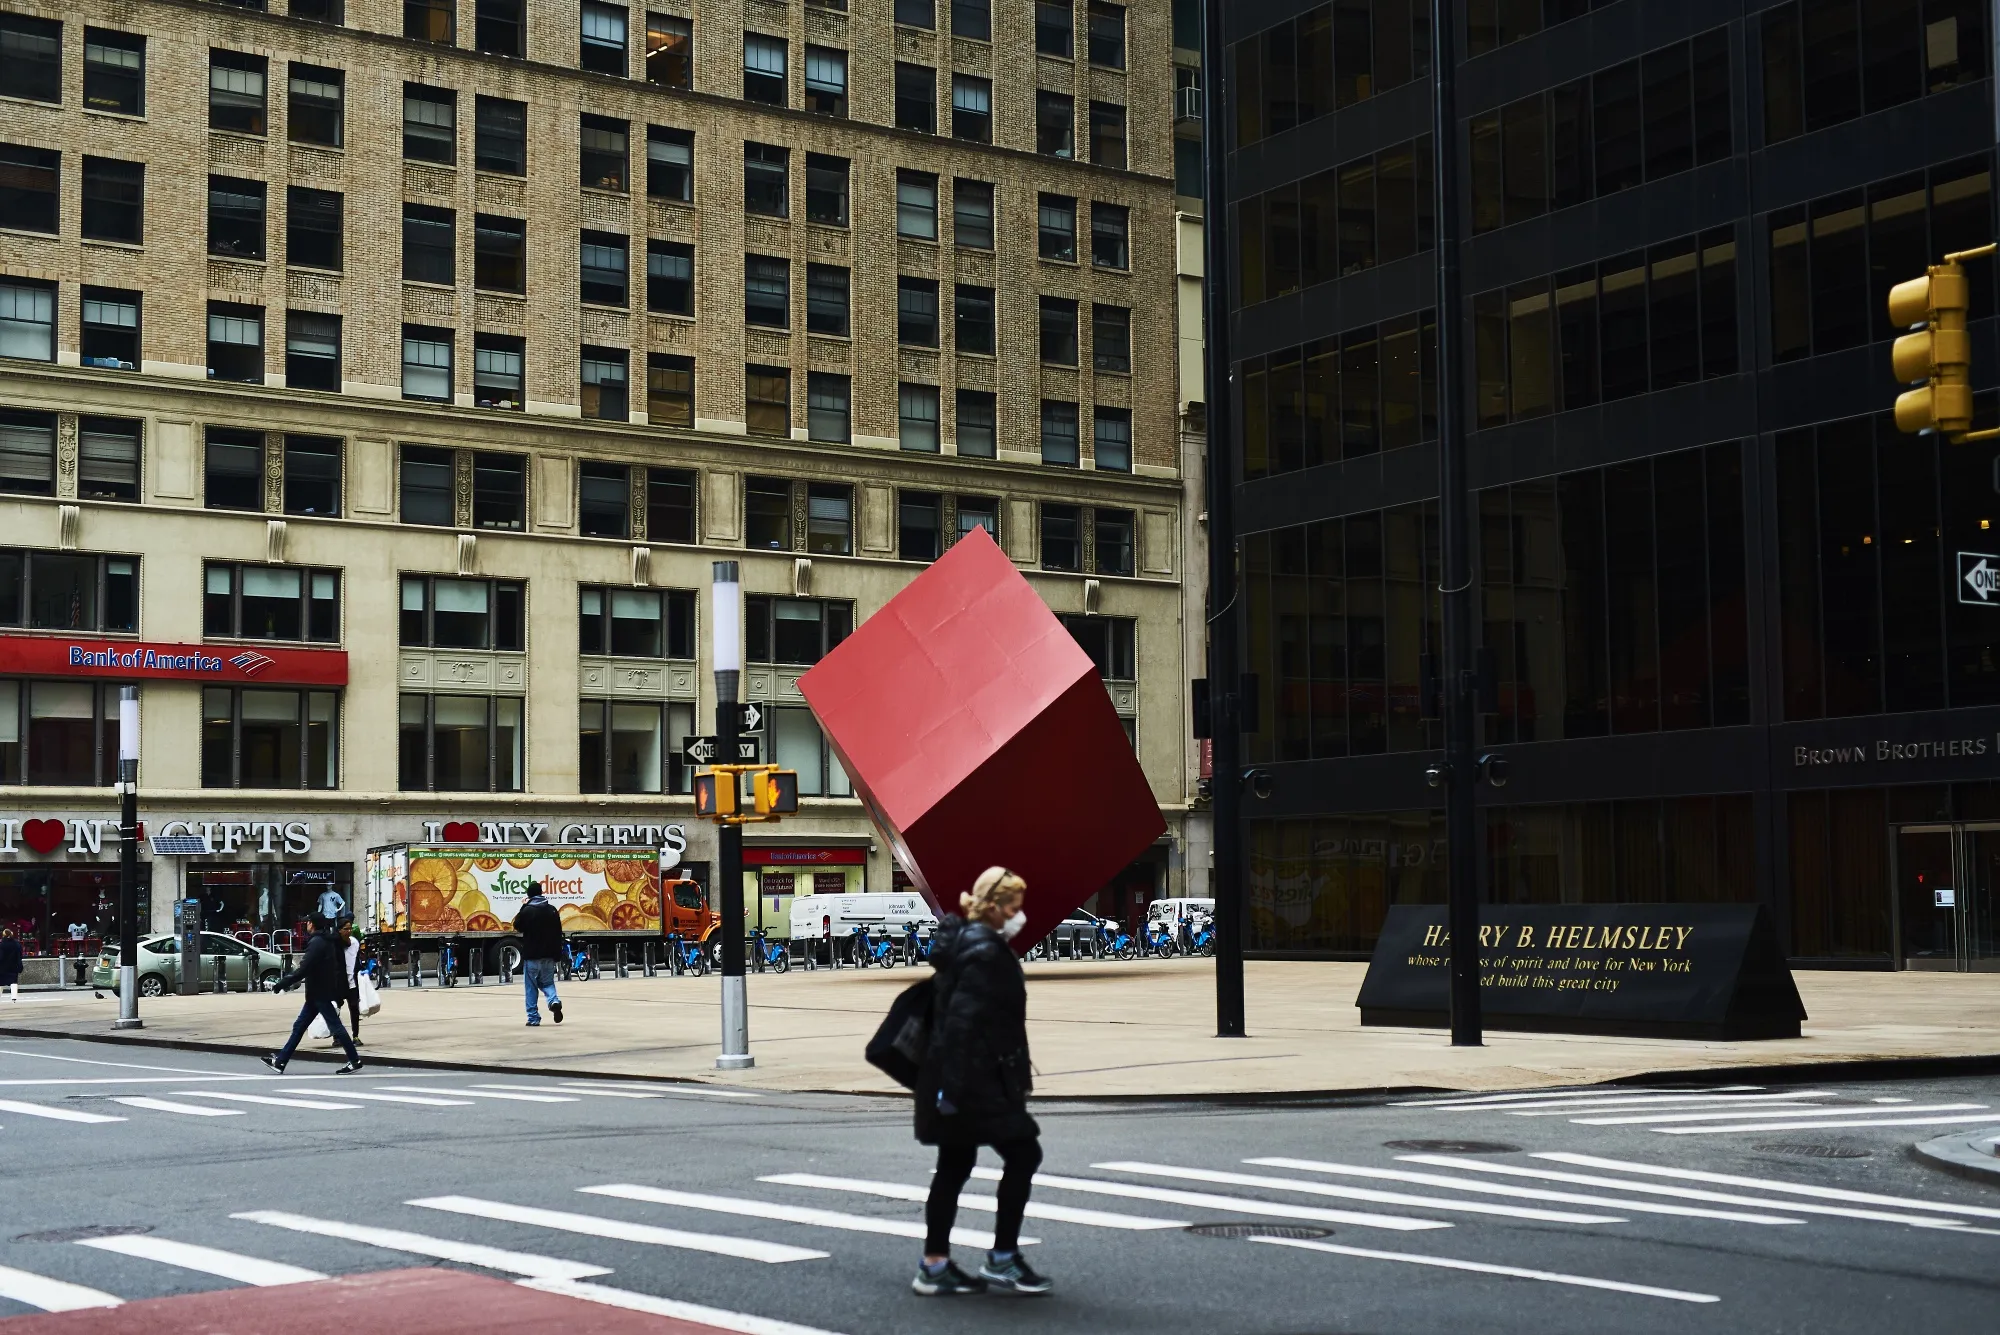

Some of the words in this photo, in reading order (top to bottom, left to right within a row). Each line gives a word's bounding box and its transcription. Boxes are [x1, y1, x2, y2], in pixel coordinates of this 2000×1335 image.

[1976, 569, 2000, 589] ONE
[69, 646, 120, 667] Bank
[120, 648, 142, 668] of
[143, 649, 222, 672] America
[694, 745, 715, 757] ONE
[1794, 746, 1866, 766] BROWN
[1876, 738, 1986, 761] BROTHERS
[0, 819, 20, 854] I
[422, 821, 441, 843] I
[481, 822, 549, 844] NY
[558, 822, 687, 855] GIFTS
[306, 872, 327, 880] WALL
[1423, 925, 1509, 948] HRY
[1517, 925, 1536, 948] B.
[1546, 925, 1694, 950] HELMSLEY
[1407, 954, 1440, 967] whose
[1493, 955, 1509, 968] of
[1510, 956, 1543, 971] spirit
[1547, 957, 1570, 970] and
[1574, 957, 1600, 970] love
[1604, 957, 1625, 971] for
[1628, 957, 1657, 971] New
[1662, 958, 1692, 973] York
[1498, 974, 1528, 988] build
[1532, 975, 1555, 988] this
[1557, 977, 1591, 992] great
[1594, 977, 1620, 993] city
